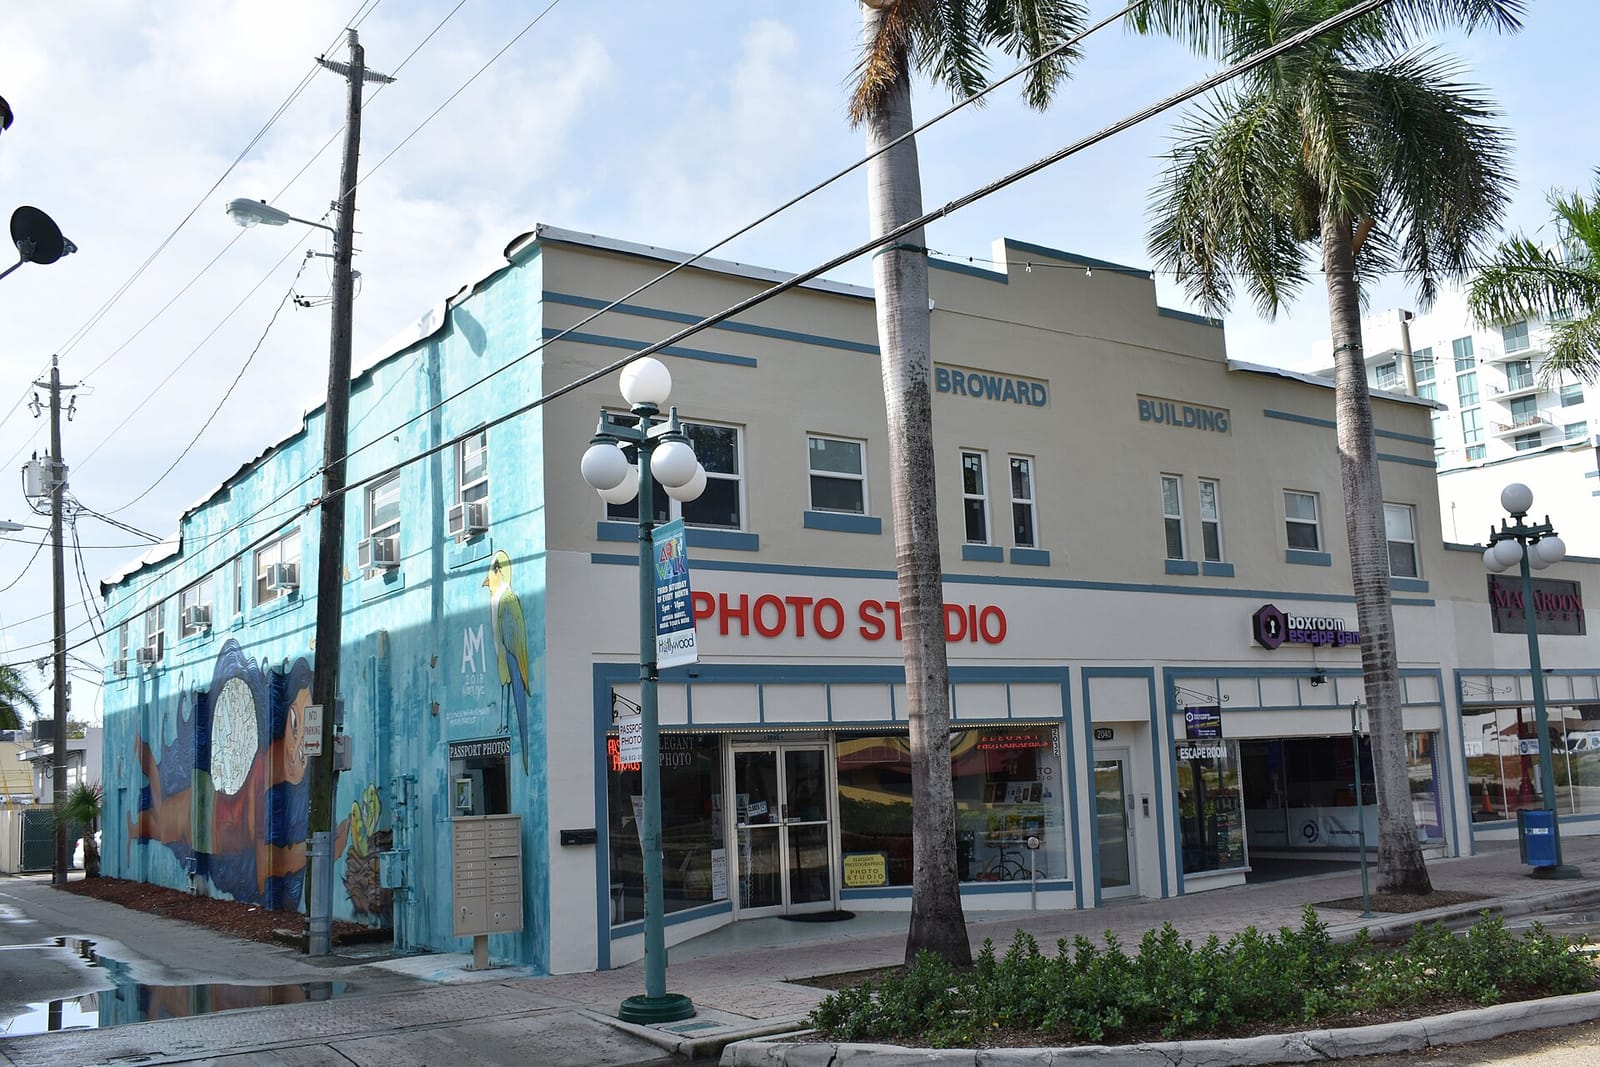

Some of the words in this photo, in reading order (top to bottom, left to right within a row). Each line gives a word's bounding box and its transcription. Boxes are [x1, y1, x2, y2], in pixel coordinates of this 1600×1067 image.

[935, 367, 1047, 407] BROWARD
[1138, 399, 1228, 433] BUILDING
[656, 556, 687, 580] WALK
[1495, 590, 1583, 611] MAAROON
[690, 591, 845, 640] PHOTO
[859, 600, 1007, 644] STDIO
[1288, 613, 1345, 631] boxroom
[659, 633, 694, 654] Hollywood
[1289, 630, 1335, 645] escape
[450, 744, 482, 758] PASSPORT
[482, 740, 511, 756] PHOTOS
[659, 736, 694, 751] LEGANT
[1180, 747, 1206, 759] ESCAPE
[1206, 746, 1228, 759] ROOM
[847, 873, 884, 881] STUDIO
